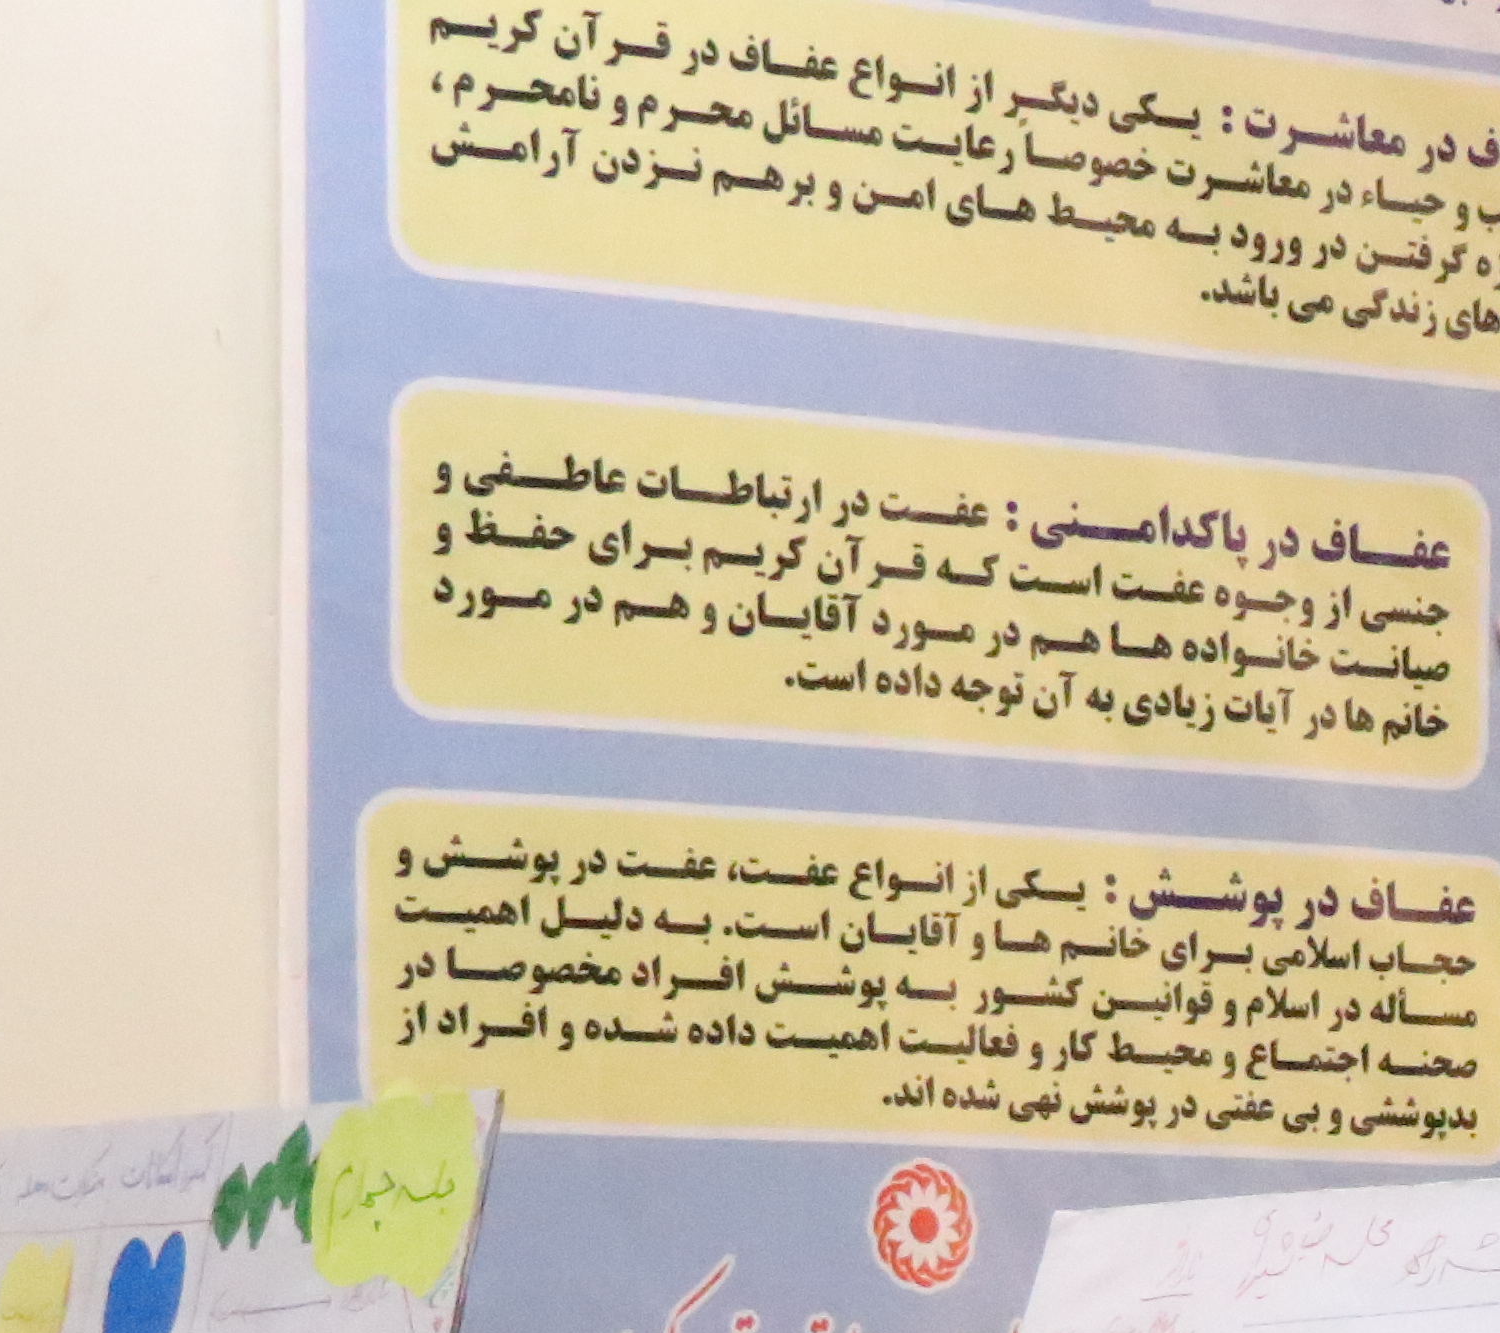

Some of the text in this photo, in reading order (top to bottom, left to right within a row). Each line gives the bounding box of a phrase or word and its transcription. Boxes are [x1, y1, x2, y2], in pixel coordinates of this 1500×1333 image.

[428, 8, 544, 55] کریم
[552, 9, 672, 68] قرآن
[680, 38, 720, 77] در
[728, 37, 839, 82] عفاف
[847, 53, 957, 105] انواع
[964, 68, 994, 115] از
[1002, 79, 1100, 126] دیگر
[1107, 91, 1202, 141] یکی
[1243, 107, 1407, 158] معاشرت
[430, 121, 582, 179] آرامش
[591, 146, 704, 191] نزدن
[1416, 132, 1458, 175] در
[825, 179, 844, 213] و
[851, 176, 937, 216] امن
[944, 182, 1037, 229] های
[1046, 190, 1157, 243] محیط
[1164, 216, 1223, 257] به
[1229, 222, 1303, 268] ورود
[1311, 233, 1348, 270] در
[1355, 234, 1468, 285] گرفتن
[1286, 293, 1335, 325] می
[1341, 287, 1438, 339] زندگی
[432, 453, 1451, 571] عفاف در پاکدامنی عفت در ارتباطات عاطفی و
[393, 845, 414, 879] و
[421, 834, 561, 887] پوشش
[568, 847, 608, 887] در
[615, 847, 718, 882] عفت
[847, 857, 955, 903] انواع
[961, 864, 988, 908] از
[994, 868, 1087, 913] یکی
[1128, 867, 1284, 929] پوشش
[1293, 884, 1340, 931] در
[1350, 877, 1476, 926] عفاف
